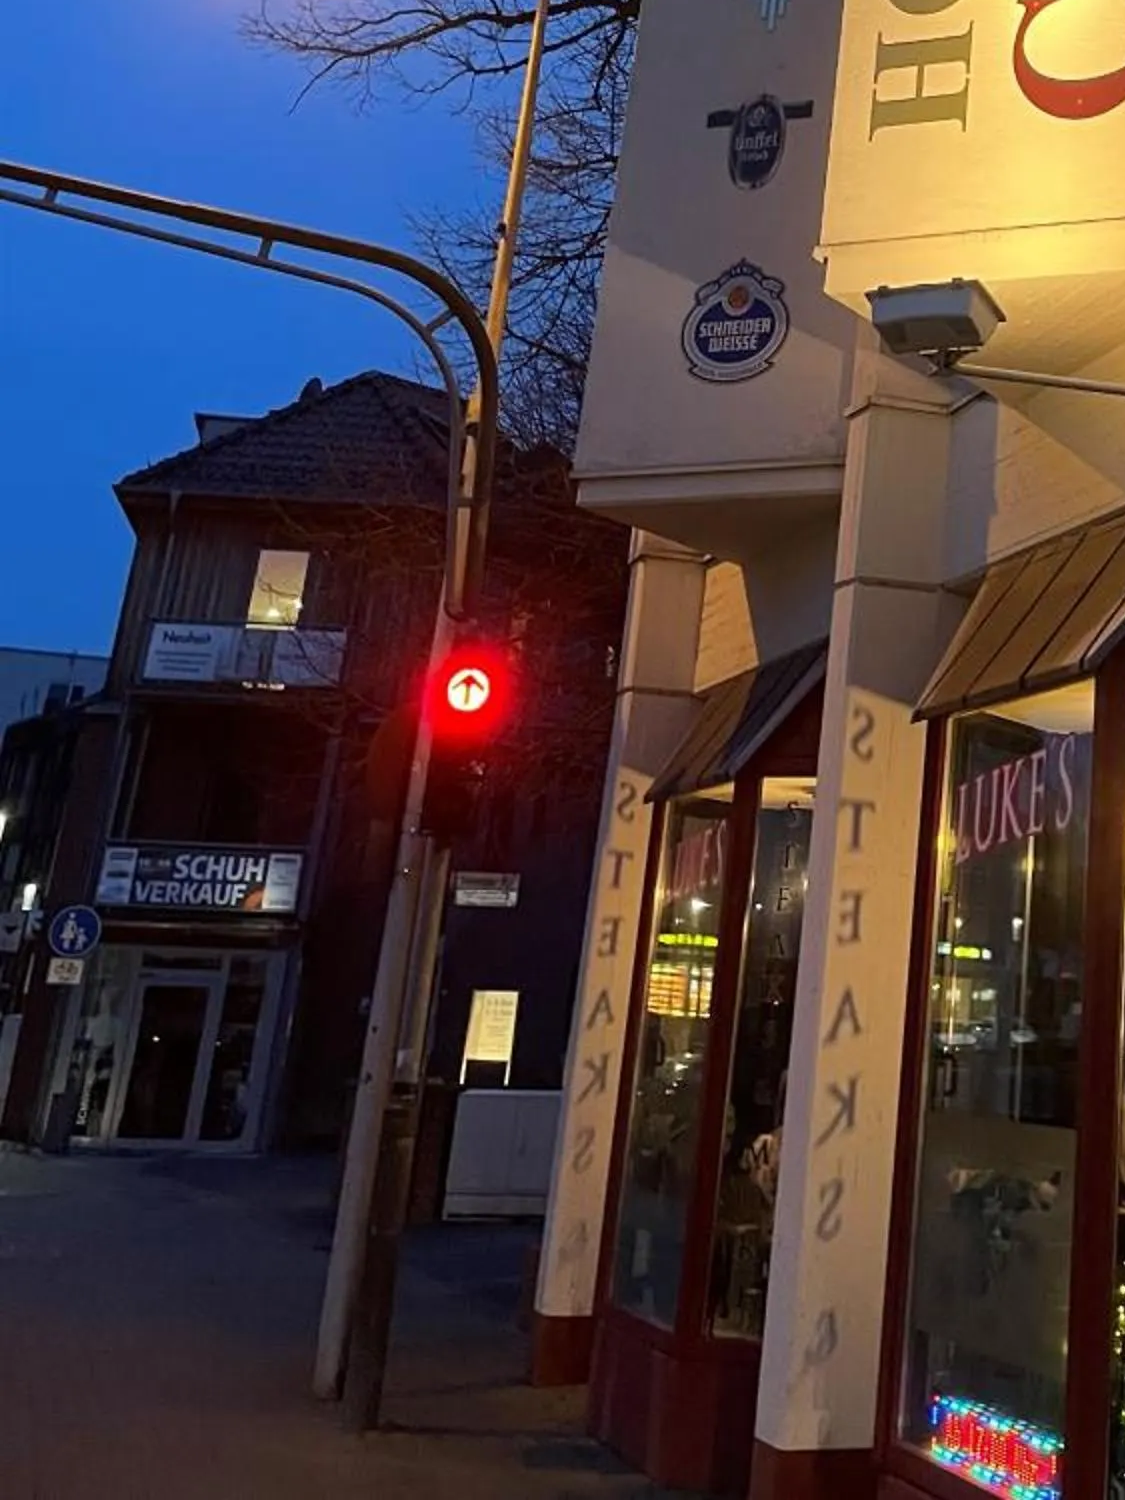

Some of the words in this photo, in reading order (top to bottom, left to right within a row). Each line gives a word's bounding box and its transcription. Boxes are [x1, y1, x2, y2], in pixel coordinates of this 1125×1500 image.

[699, 317, 771, 338] SCHNEIDER
[708, 334, 758, 353] WEISSE
[955, 732, 1077, 864] LUKE'S
[172, 853, 266, 883] SCHUH
[135, 881, 247, 906] VERKAUF
